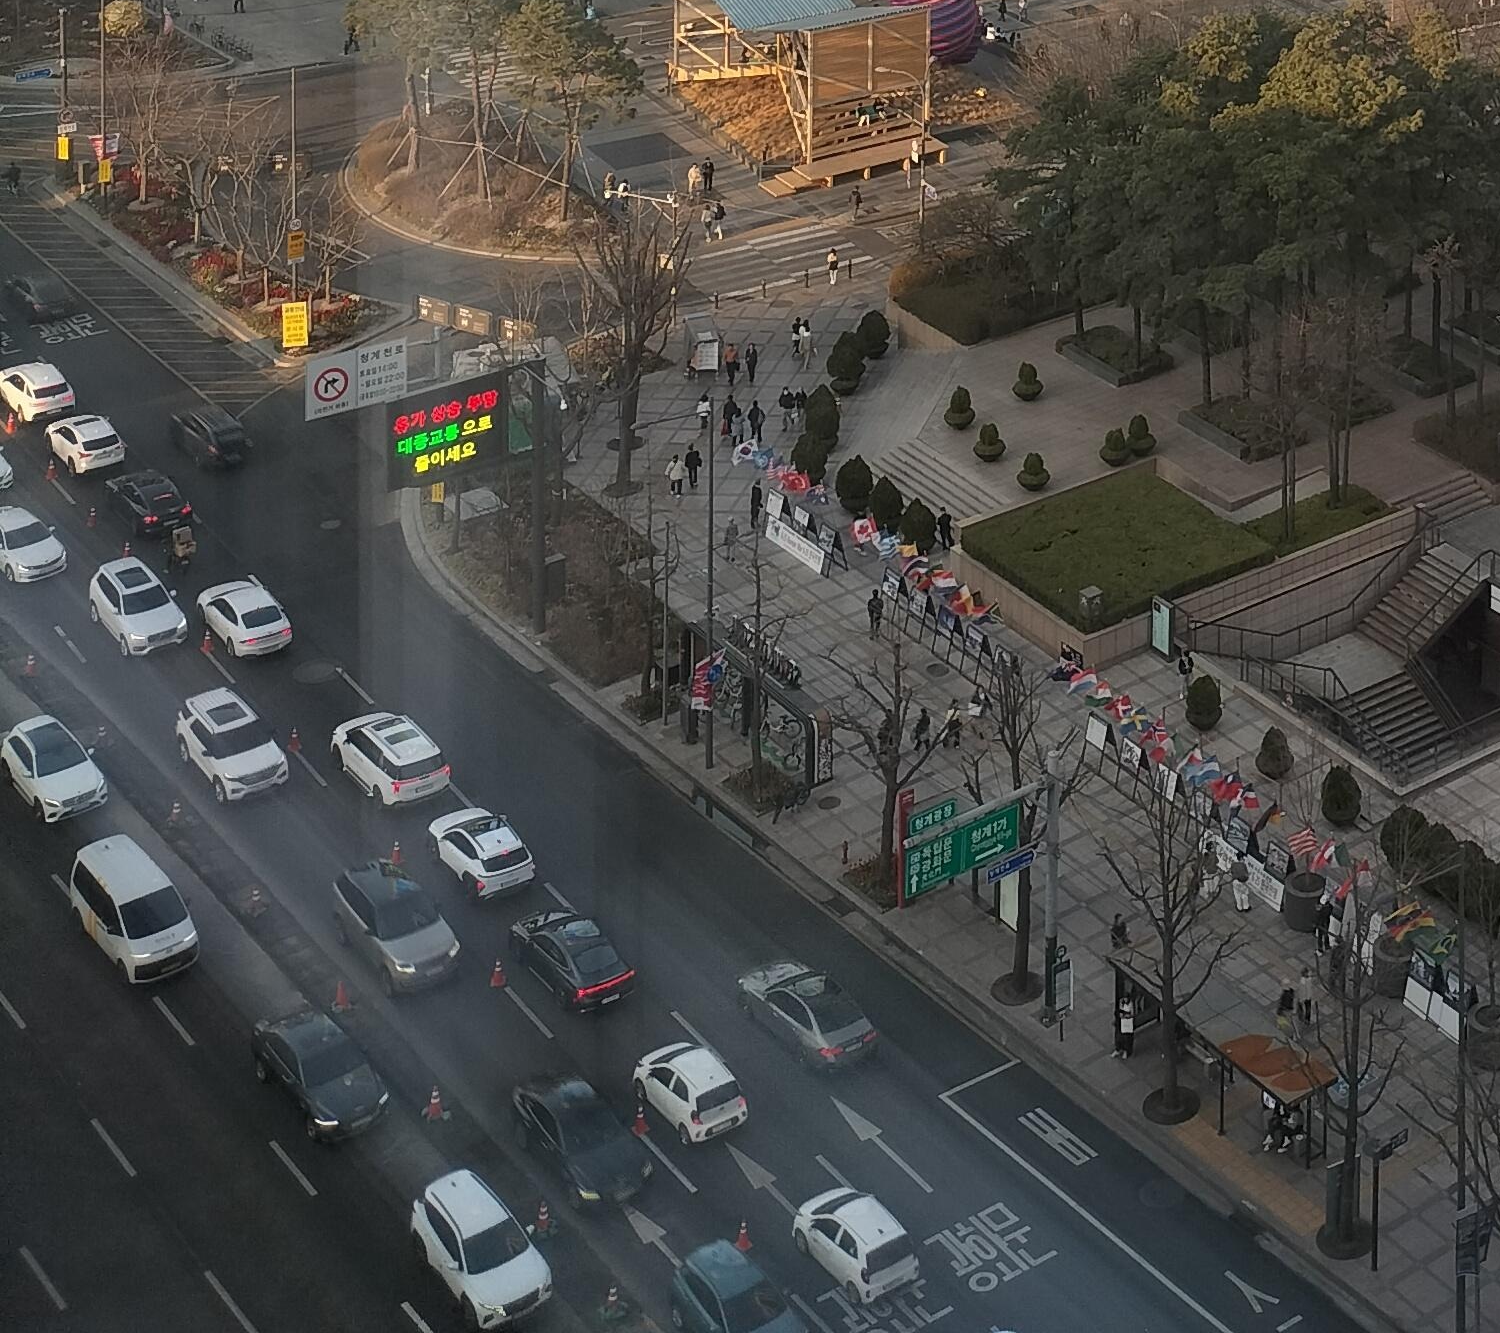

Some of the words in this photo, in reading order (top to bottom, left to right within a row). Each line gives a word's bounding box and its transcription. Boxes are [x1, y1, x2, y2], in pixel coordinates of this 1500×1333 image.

[360, 344, 404, 363] 청계천로
[397, 415, 493, 454] 대중교통으로
[415, 441, 477, 473] 줄이세요
[923, 1201, 1058, 1293] 광화문
